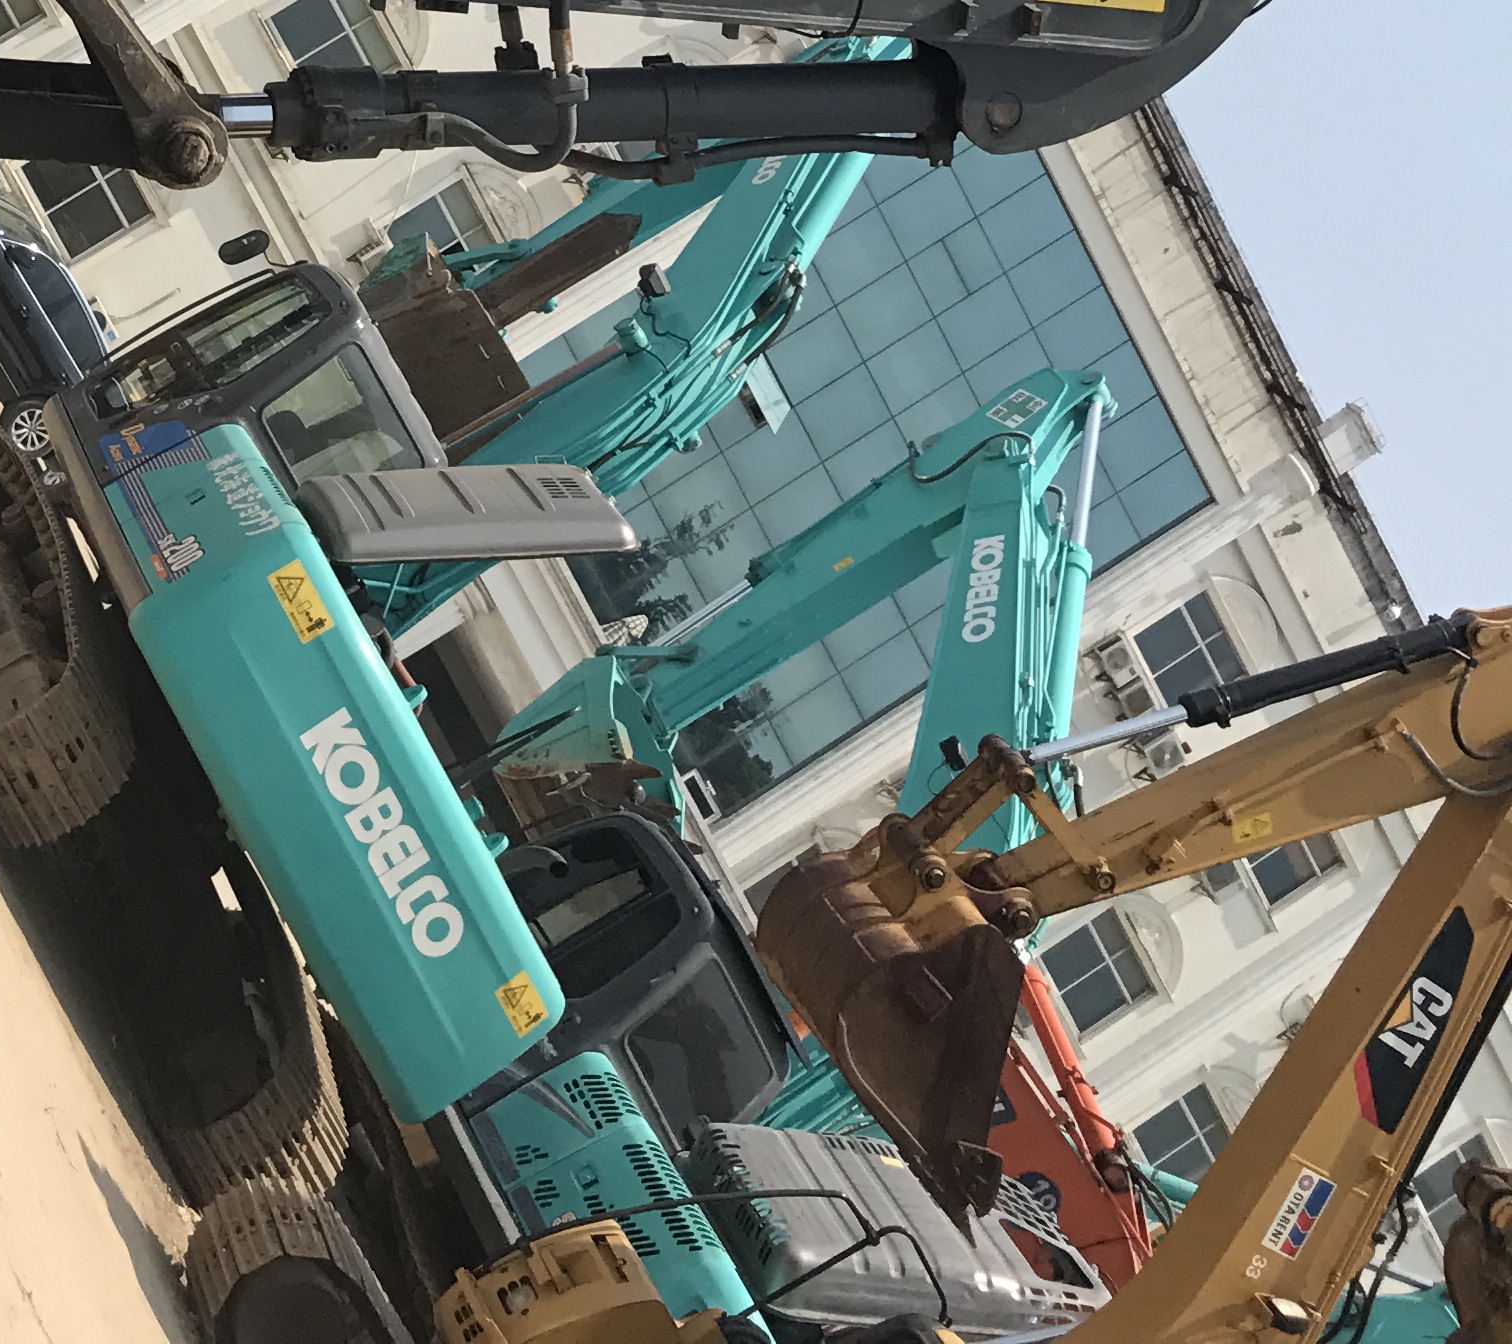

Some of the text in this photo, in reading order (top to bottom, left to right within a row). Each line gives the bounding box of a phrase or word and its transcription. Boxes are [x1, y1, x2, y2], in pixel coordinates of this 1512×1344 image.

[961, 534, 1006, 643] KOBELCO
[299, 706, 464, 958] KOBELCO
[1378, 976, 1454, 1069] CAT
[1245, 1254, 1268, 1280] 33
[1268, 1215, 1291, 1247] RENT
